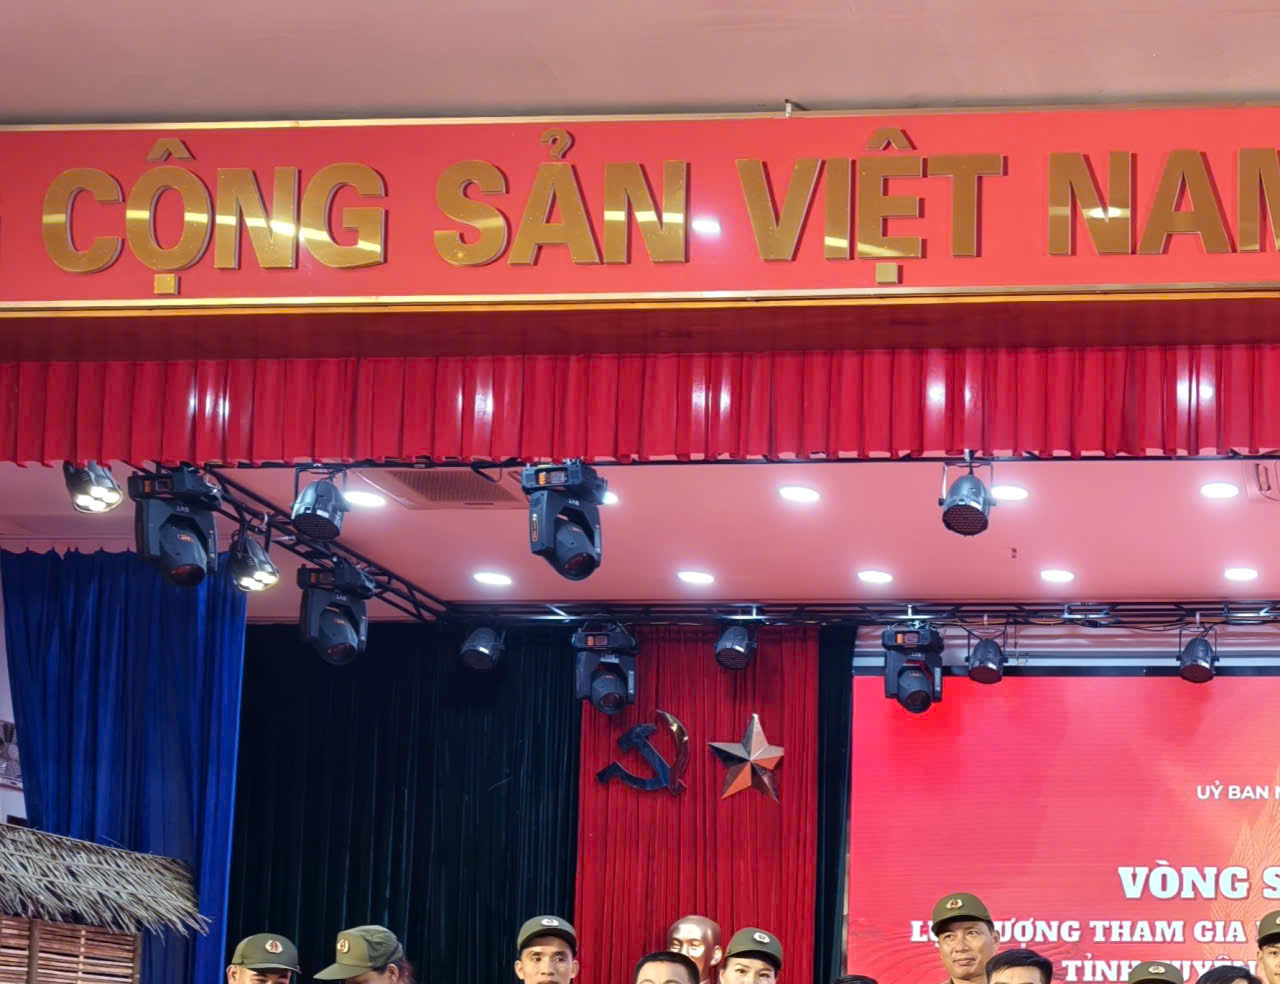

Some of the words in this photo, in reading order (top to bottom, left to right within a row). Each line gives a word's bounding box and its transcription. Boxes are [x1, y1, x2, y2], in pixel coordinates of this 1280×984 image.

[42, 137, 389, 297] CỘNG
[432, 128, 690, 267] SẢN
[736, 127, 1008, 285] VIỆT
[1228, 785, 1266, 799] BAN
[1118, 860, 1250, 899] VÒNG
[994, 917, 1081, 948] ƯỢNG
[1090, 920, 1184, 942] THAM
[1193, 920, 1247, 942] GIA
